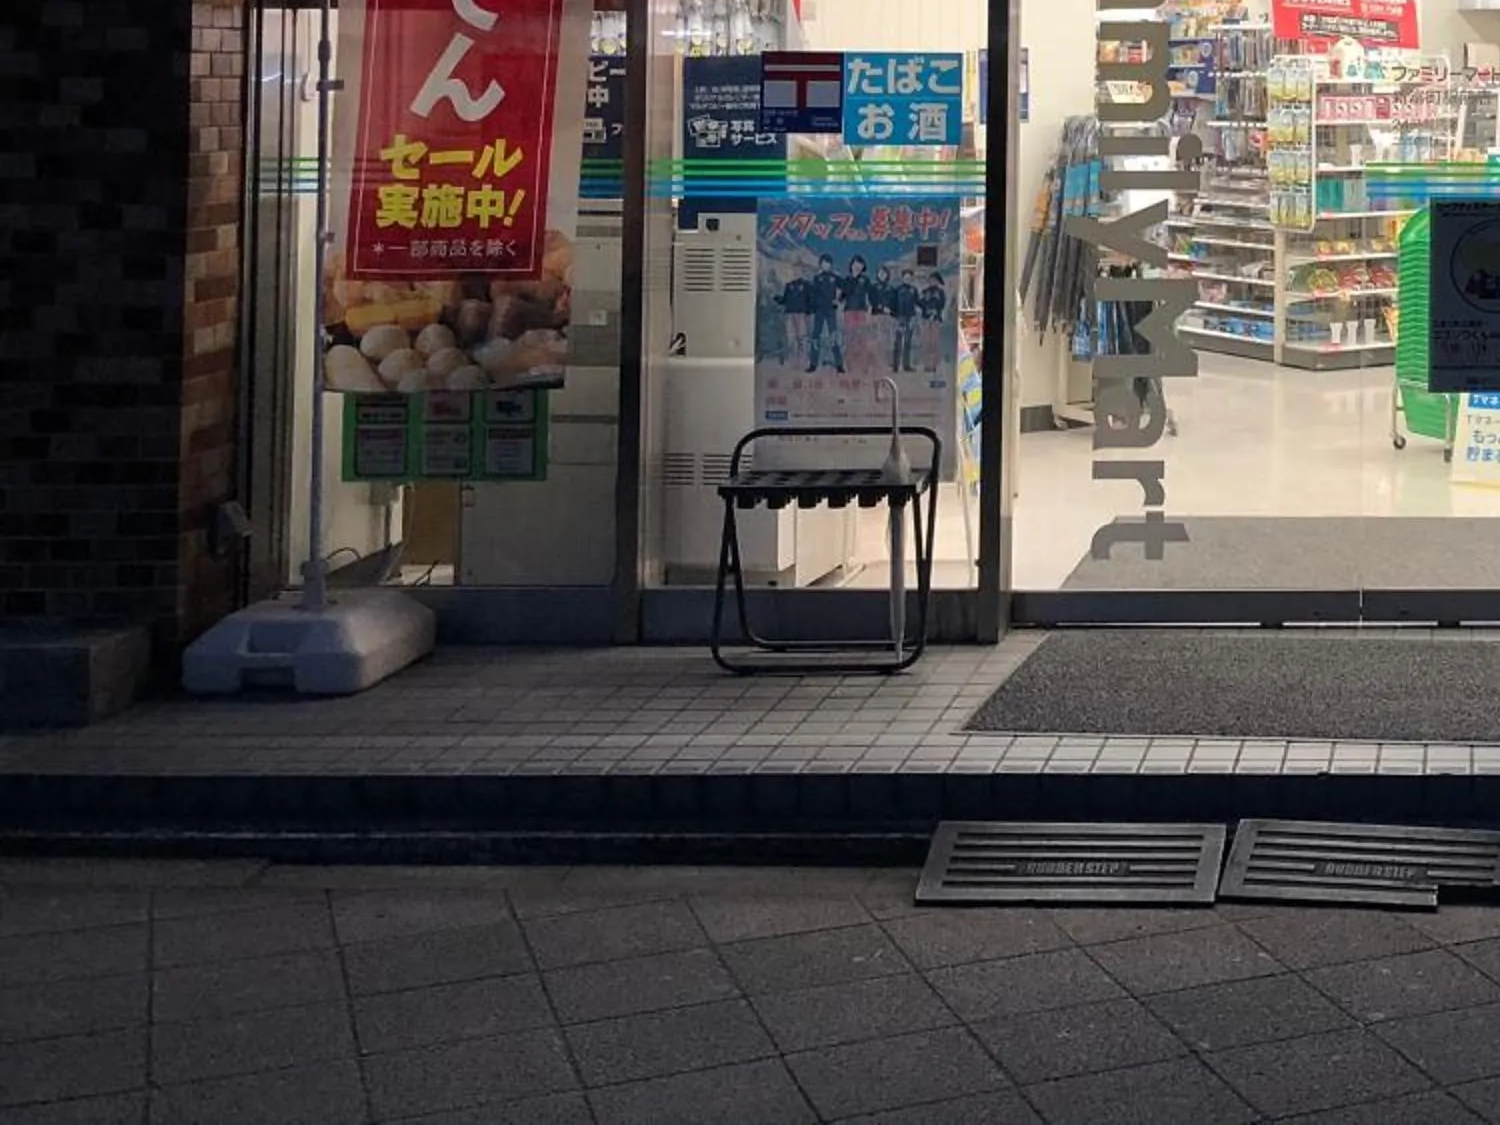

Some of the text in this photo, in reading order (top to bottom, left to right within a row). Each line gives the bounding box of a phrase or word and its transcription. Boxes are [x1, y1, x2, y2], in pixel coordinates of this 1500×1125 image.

[847, 56, 962, 95] たばこ
[856, 101, 950, 145] お酒
[380, 133, 524, 181] セール
[375, 182, 527, 229] 実施中!
